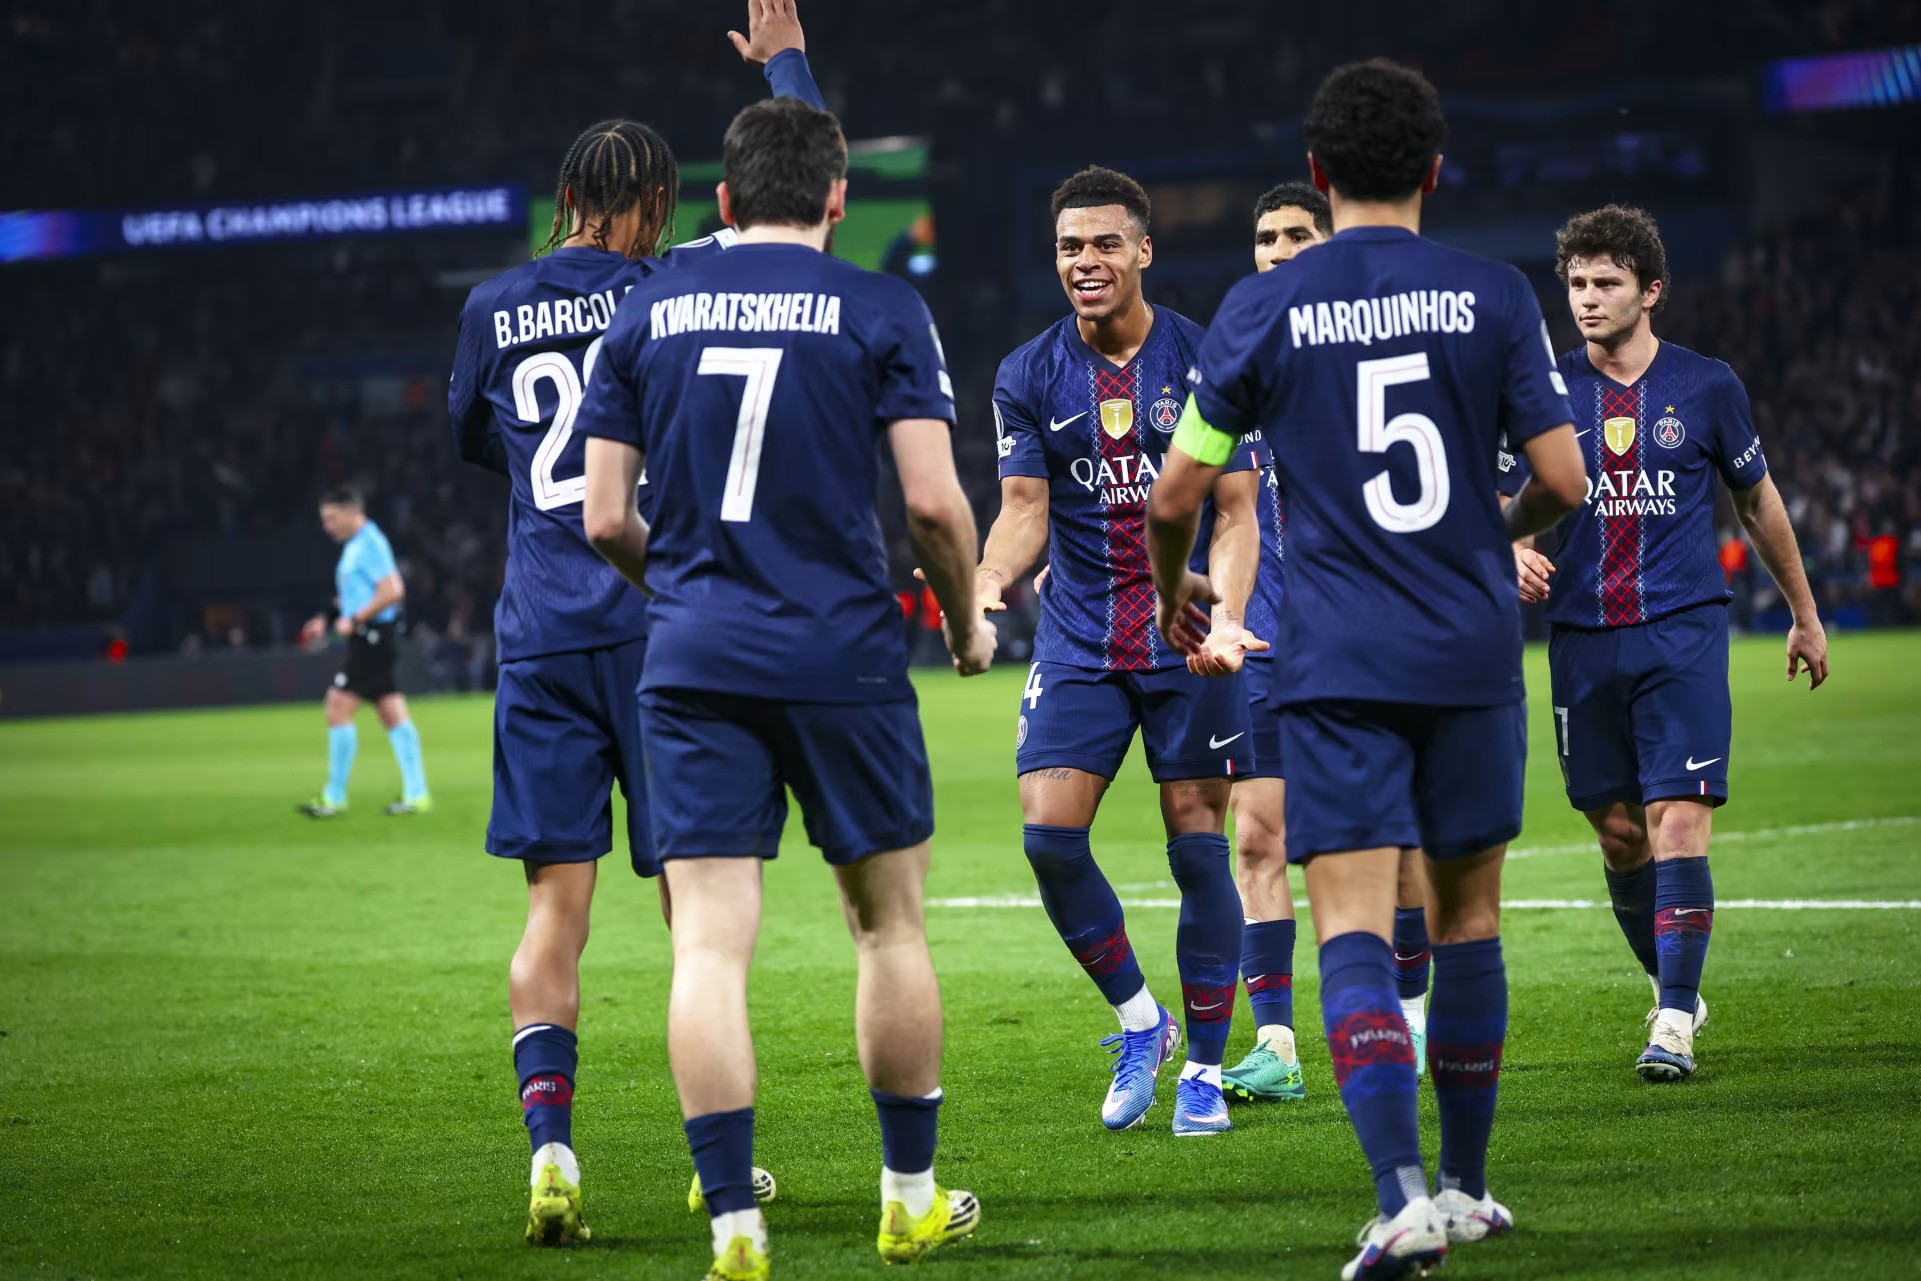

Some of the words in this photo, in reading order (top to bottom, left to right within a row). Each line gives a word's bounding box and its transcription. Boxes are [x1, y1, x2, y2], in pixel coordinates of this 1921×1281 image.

[122, 213, 203, 244] UEFA
[205, 198, 388, 239] CHAMPIONS
[390, 189, 510, 226] LEAGUE
[494, 285, 635, 348] B.BARCOL
[650, 292, 840, 340] KVARATSKHELIA
[1289, 290, 1475, 348] MARQUINHOS
[1155, 399, 1177, 408] PARIS
[696, 347, 784, 522] 7
[1357, 352, 1450, 533] 5
[1070, 453, 1168, 492] QATA
[1099, 483, 1152, 505] AIRW
[1594, 498, 1677, 517] AIRWAYS
[522, 1081, 556, 1100] PARIS
